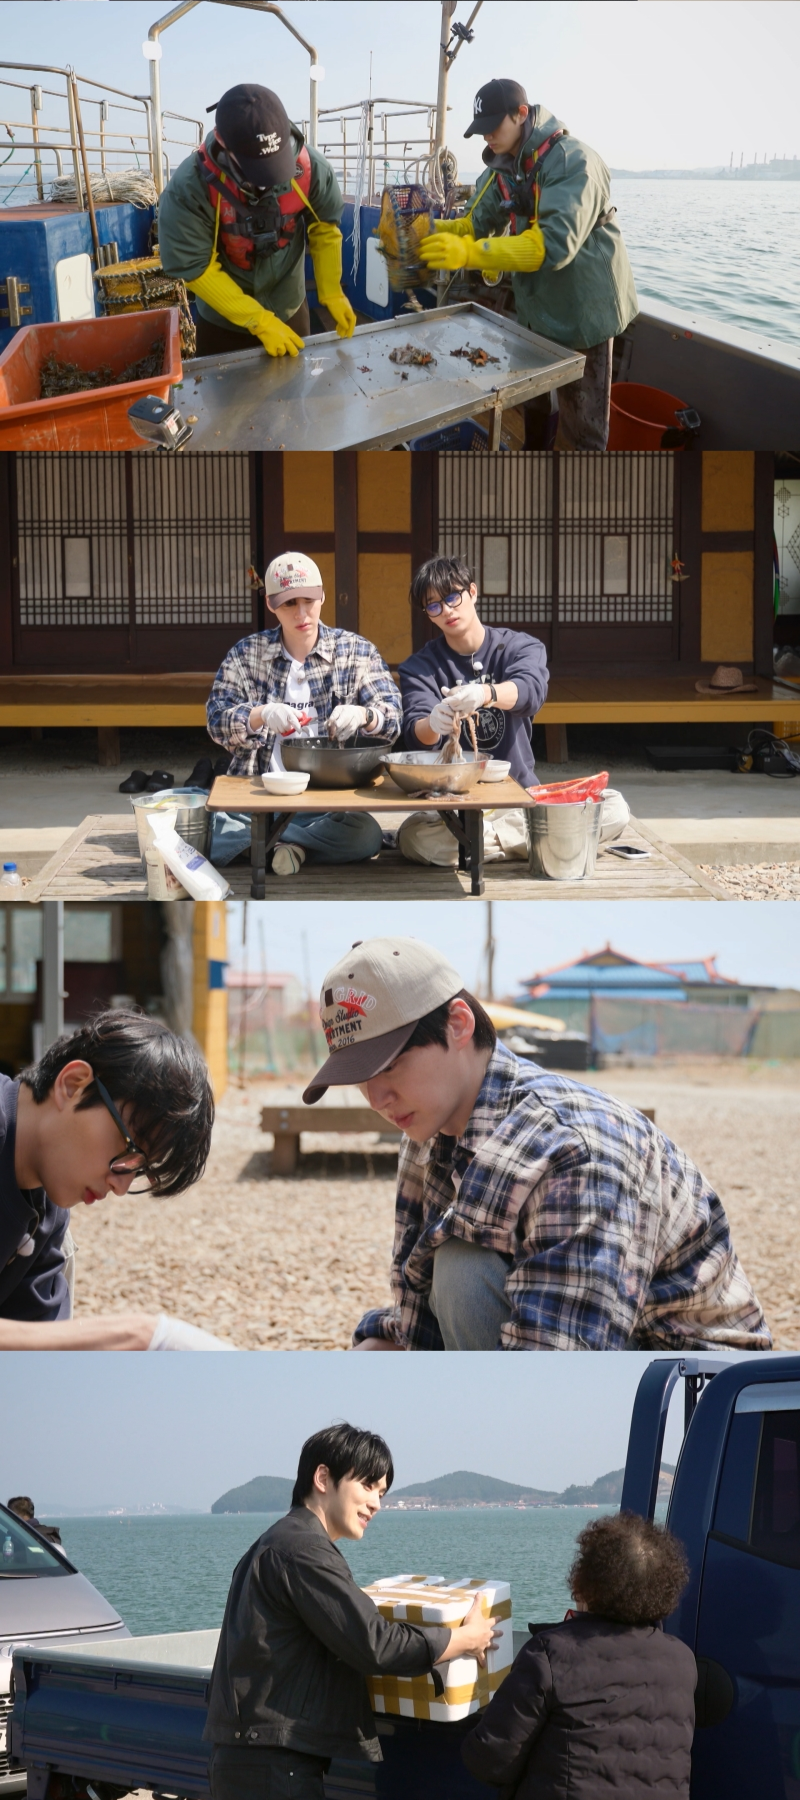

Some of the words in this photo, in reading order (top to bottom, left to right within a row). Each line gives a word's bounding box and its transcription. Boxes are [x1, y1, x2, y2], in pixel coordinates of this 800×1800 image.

[256, 132, 277, 142] Type
[333, 987, 377, 1011] GRID
[335, 1006, 359, 1024] Studio
[338, 1035, 355, 1048] 2016
